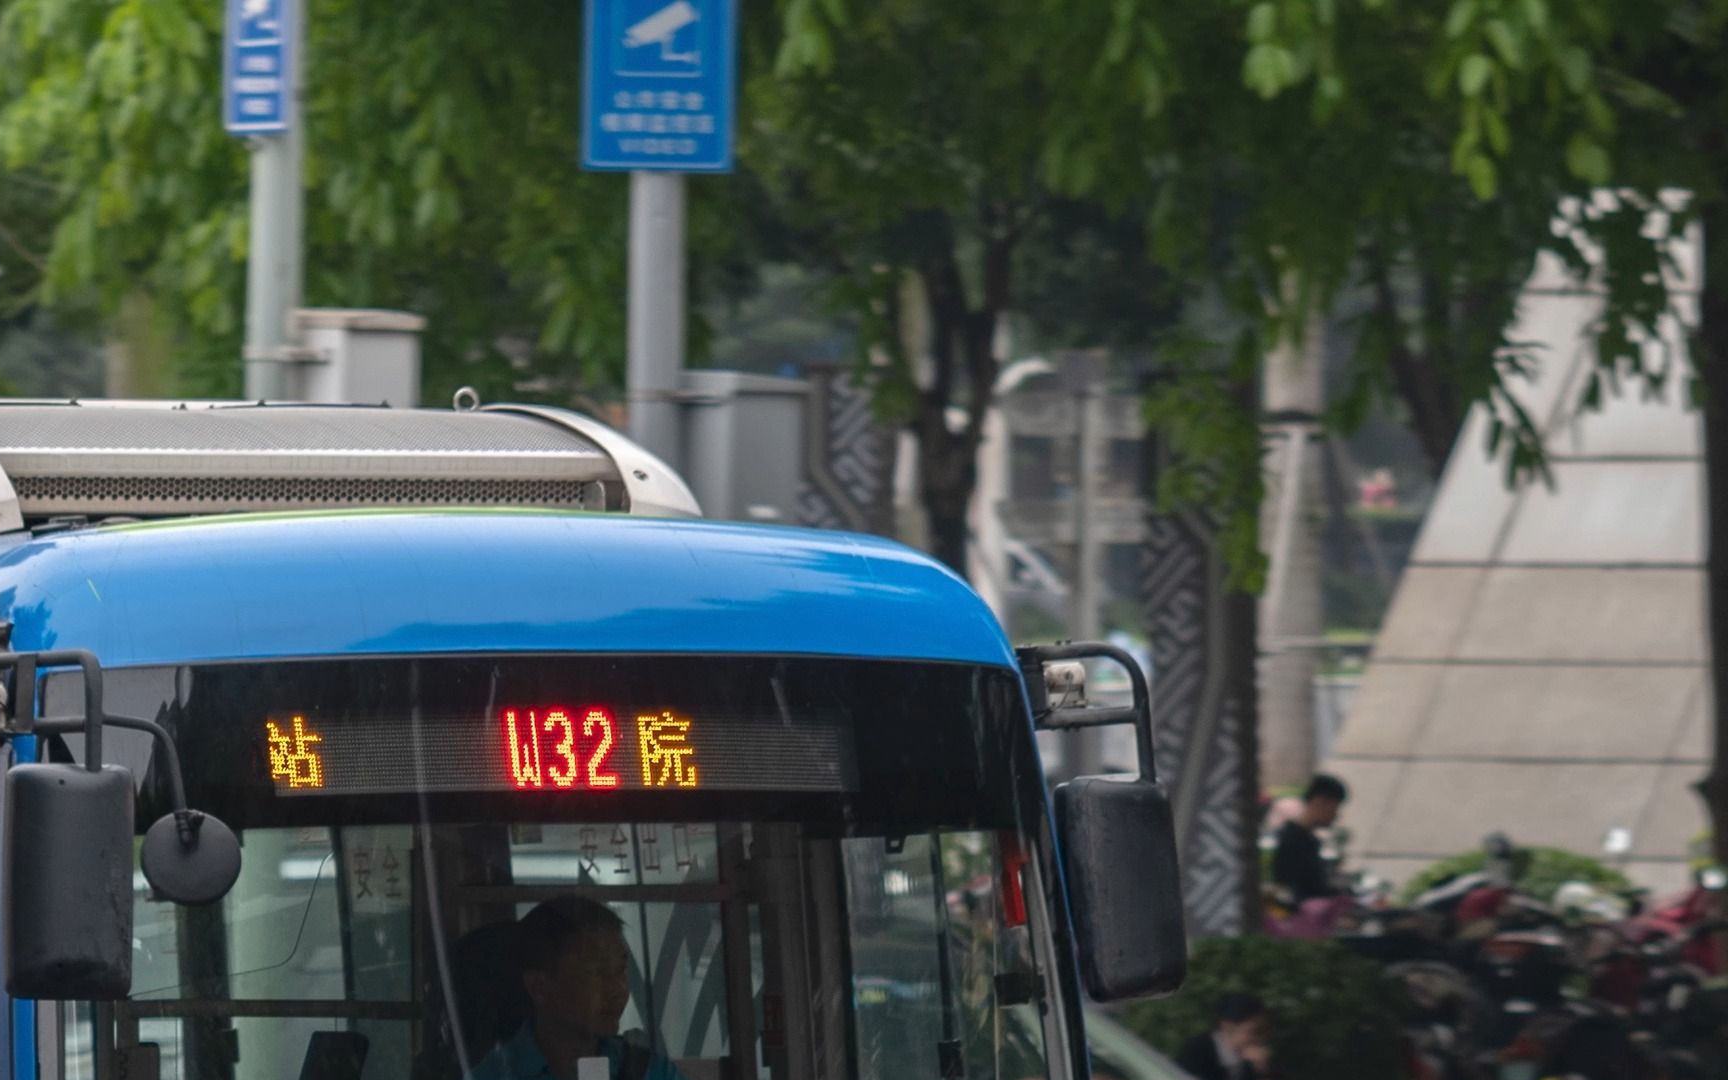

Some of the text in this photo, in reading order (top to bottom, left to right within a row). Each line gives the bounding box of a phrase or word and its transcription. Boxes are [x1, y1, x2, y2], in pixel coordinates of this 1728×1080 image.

[266, 711, 697, 788] 站 W32 院
